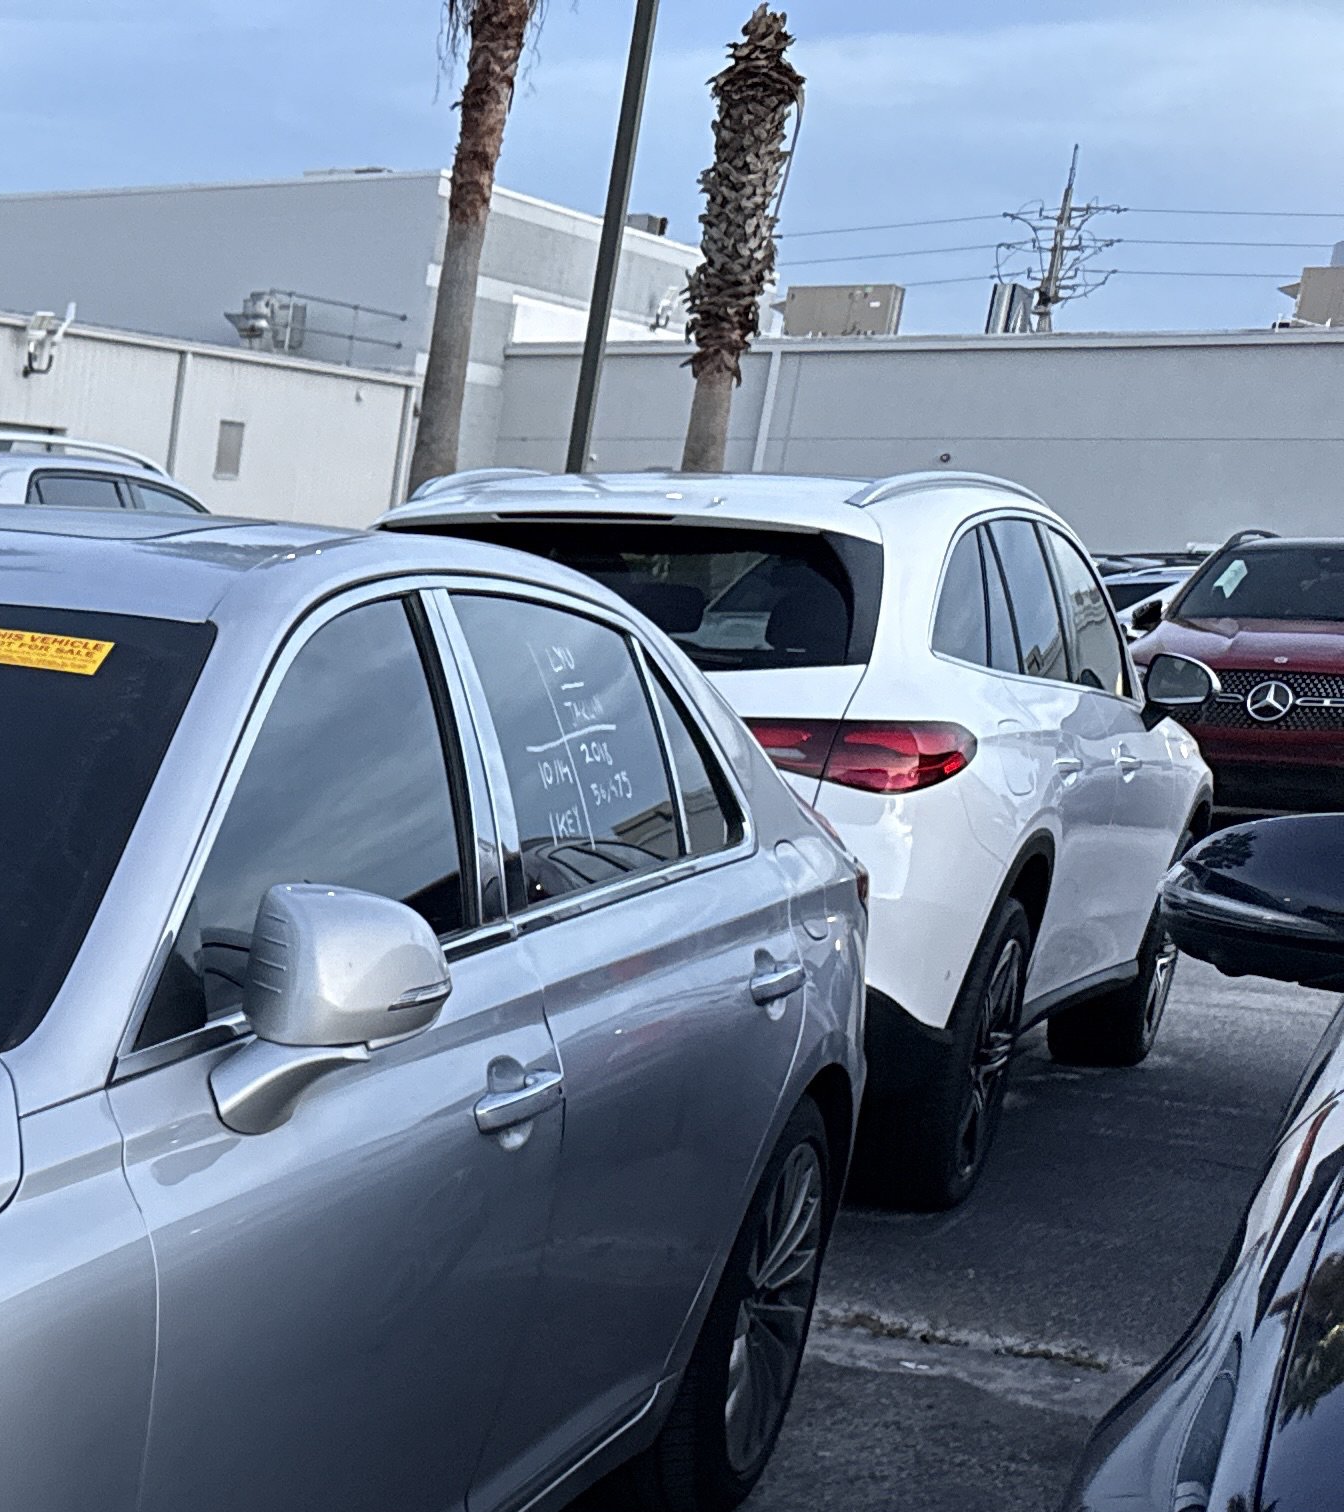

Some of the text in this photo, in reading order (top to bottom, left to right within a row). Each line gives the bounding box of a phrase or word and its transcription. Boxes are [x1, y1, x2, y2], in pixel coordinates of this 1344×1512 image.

[19, 642, 50, 652] FOR
[55, 647, 95, 658] SALE
[30, 634, 105, 651] VEHICLE
